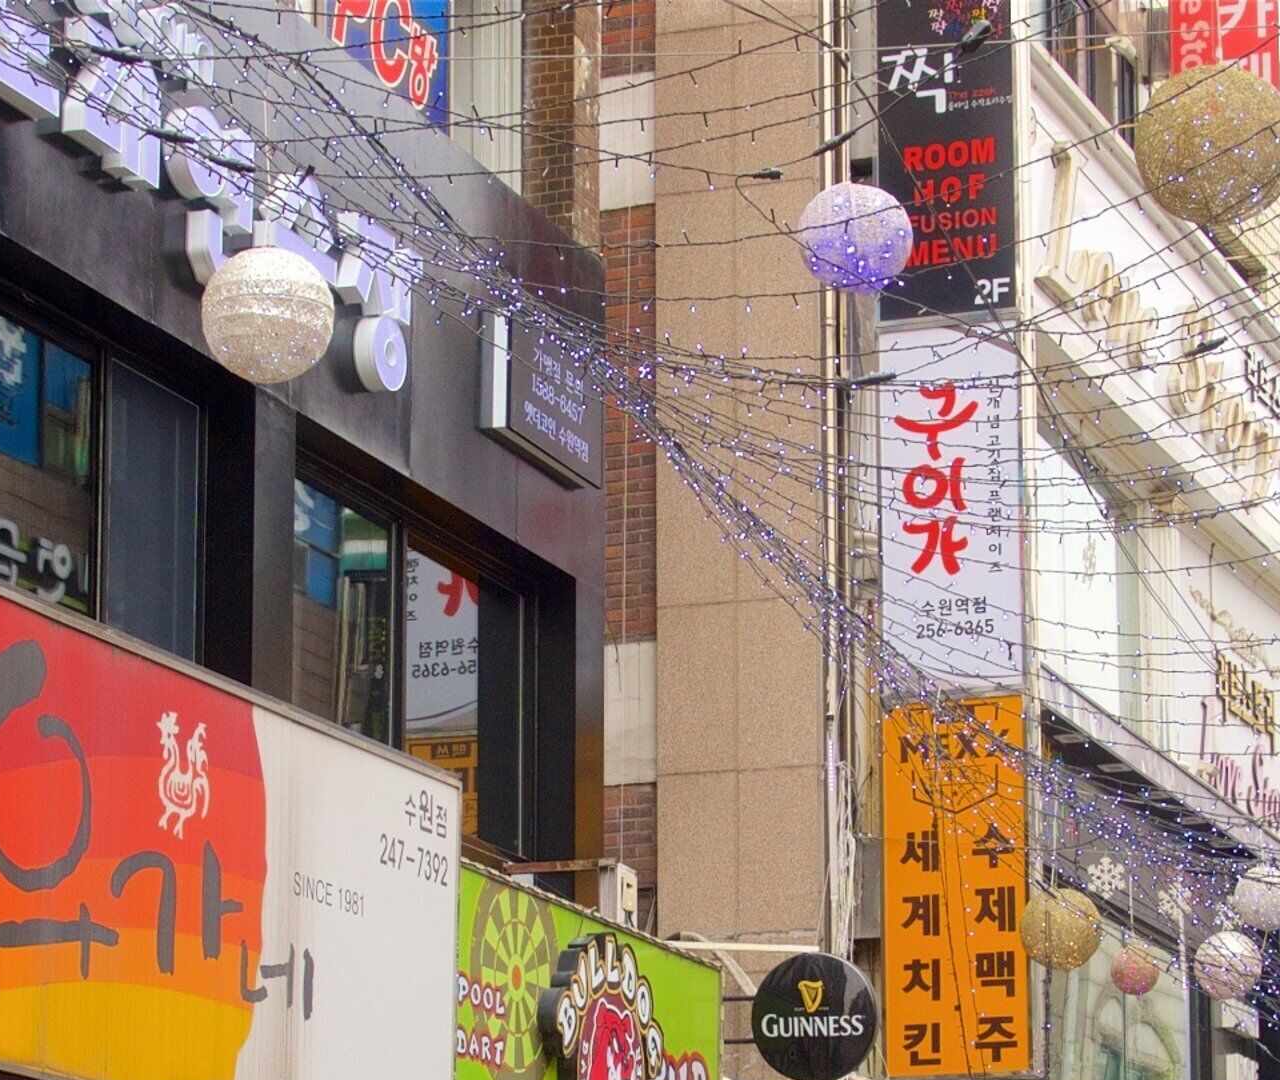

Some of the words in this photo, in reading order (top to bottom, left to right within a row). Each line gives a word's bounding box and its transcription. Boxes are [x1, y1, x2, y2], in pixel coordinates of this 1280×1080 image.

[903, 136, 997, 174] ROOM
[913, 172, 986, 207] HOF
[910, 206, 998, 235] FUSION
[906, 232, 999, 268] MENU
[975, 276, 1011, 304] 2F
[893, 379, 979, 576] 구이가
[919, 595, 989, 618] 수원역점
[915, 617, 995, 640] 256-6365
[898, 728, 1010, 765] MEXX
[404, 789, 449, 840] 수원점
[379, 833, 450, 888] 247-7392
[293, 870, 334, 907] SINCE
[337, 884, 367, 920] 1981
[899, 830, 942, 1067] 세계치킨
[971, 822, 1019, 1063] 수제맥주
[457, 980, 506, 1020] POOL
[558, 935, 663, 1079] BULLDOG
[761, 1013, 866, 1039] GUINNESS
[457, 1027, 505, 1066] DART
